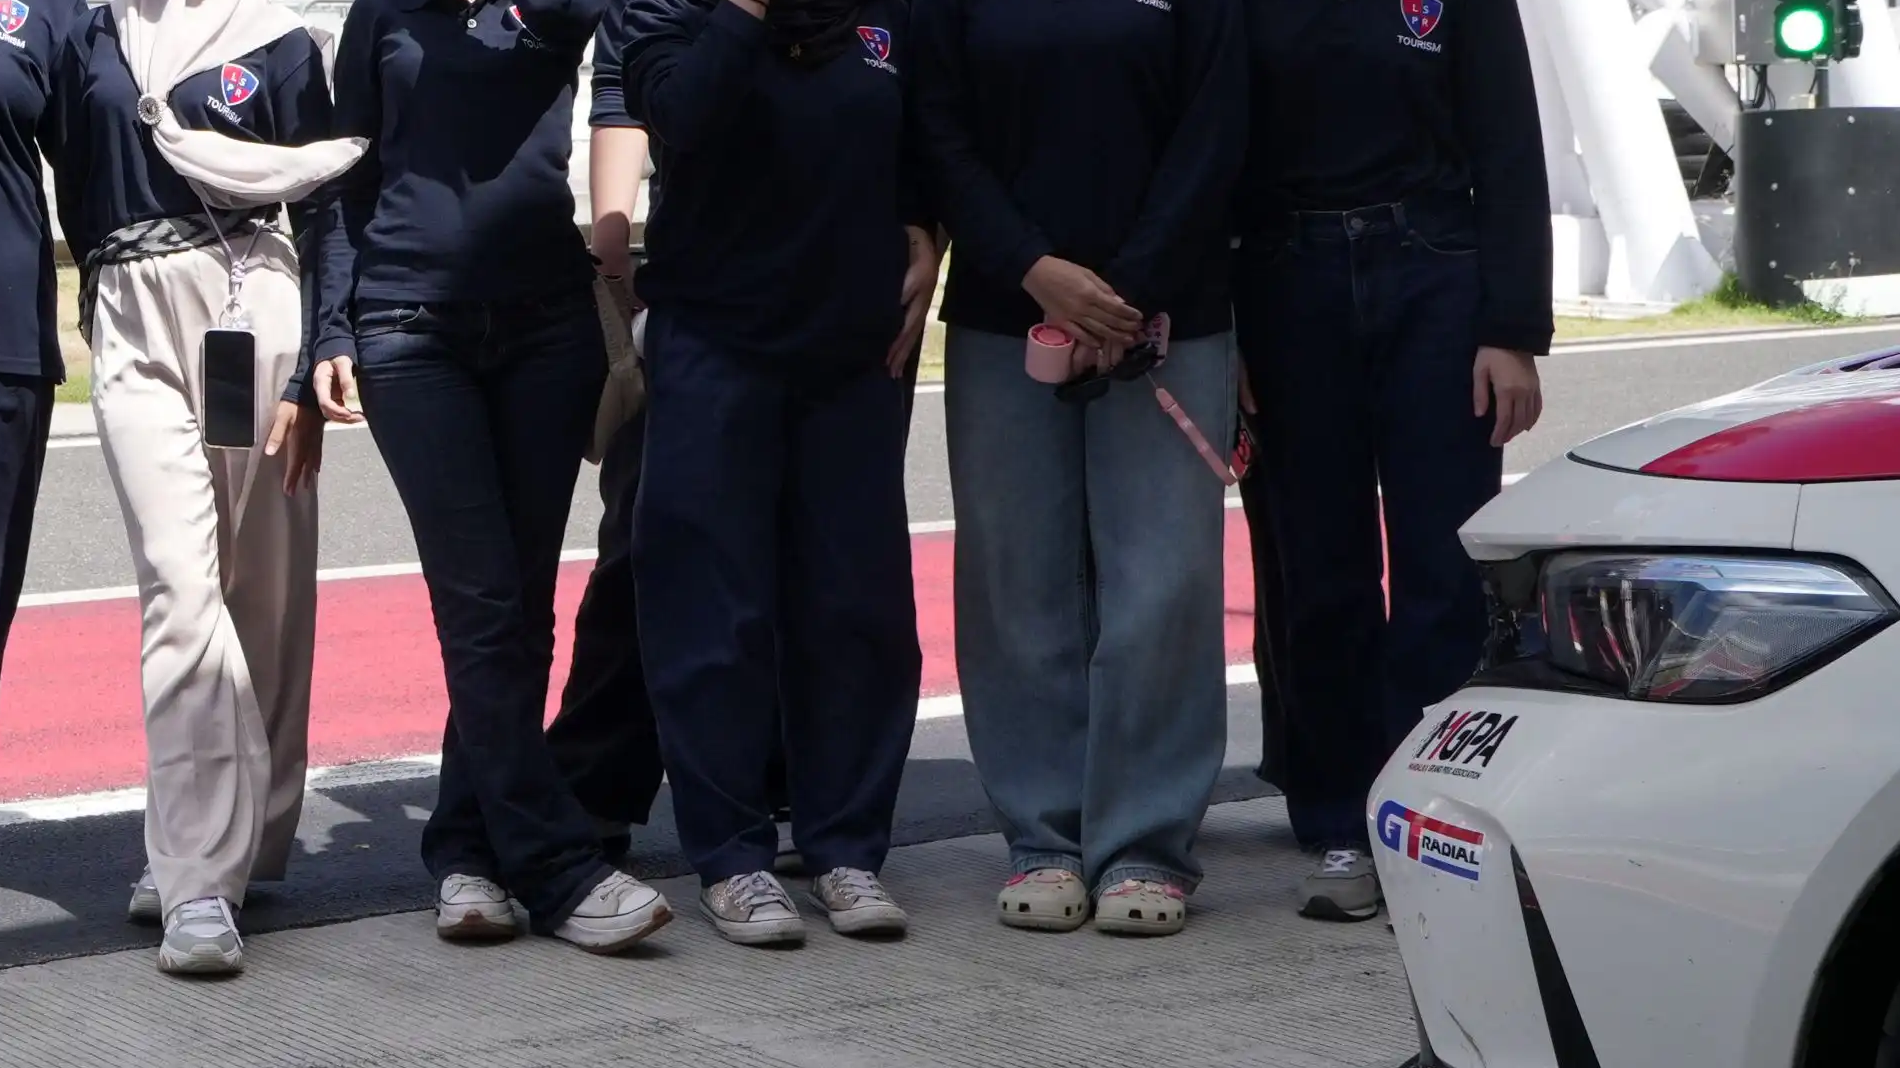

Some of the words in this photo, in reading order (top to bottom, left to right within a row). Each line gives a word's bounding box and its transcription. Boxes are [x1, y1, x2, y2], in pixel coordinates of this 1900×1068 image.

[1396, 34, 1442, 53] TOURISM
[207, 95, 243, 125] TOURISM
[1416, 710, 1520, 768] MGPA
[1421, 835, 1481, 866] RADIAL
